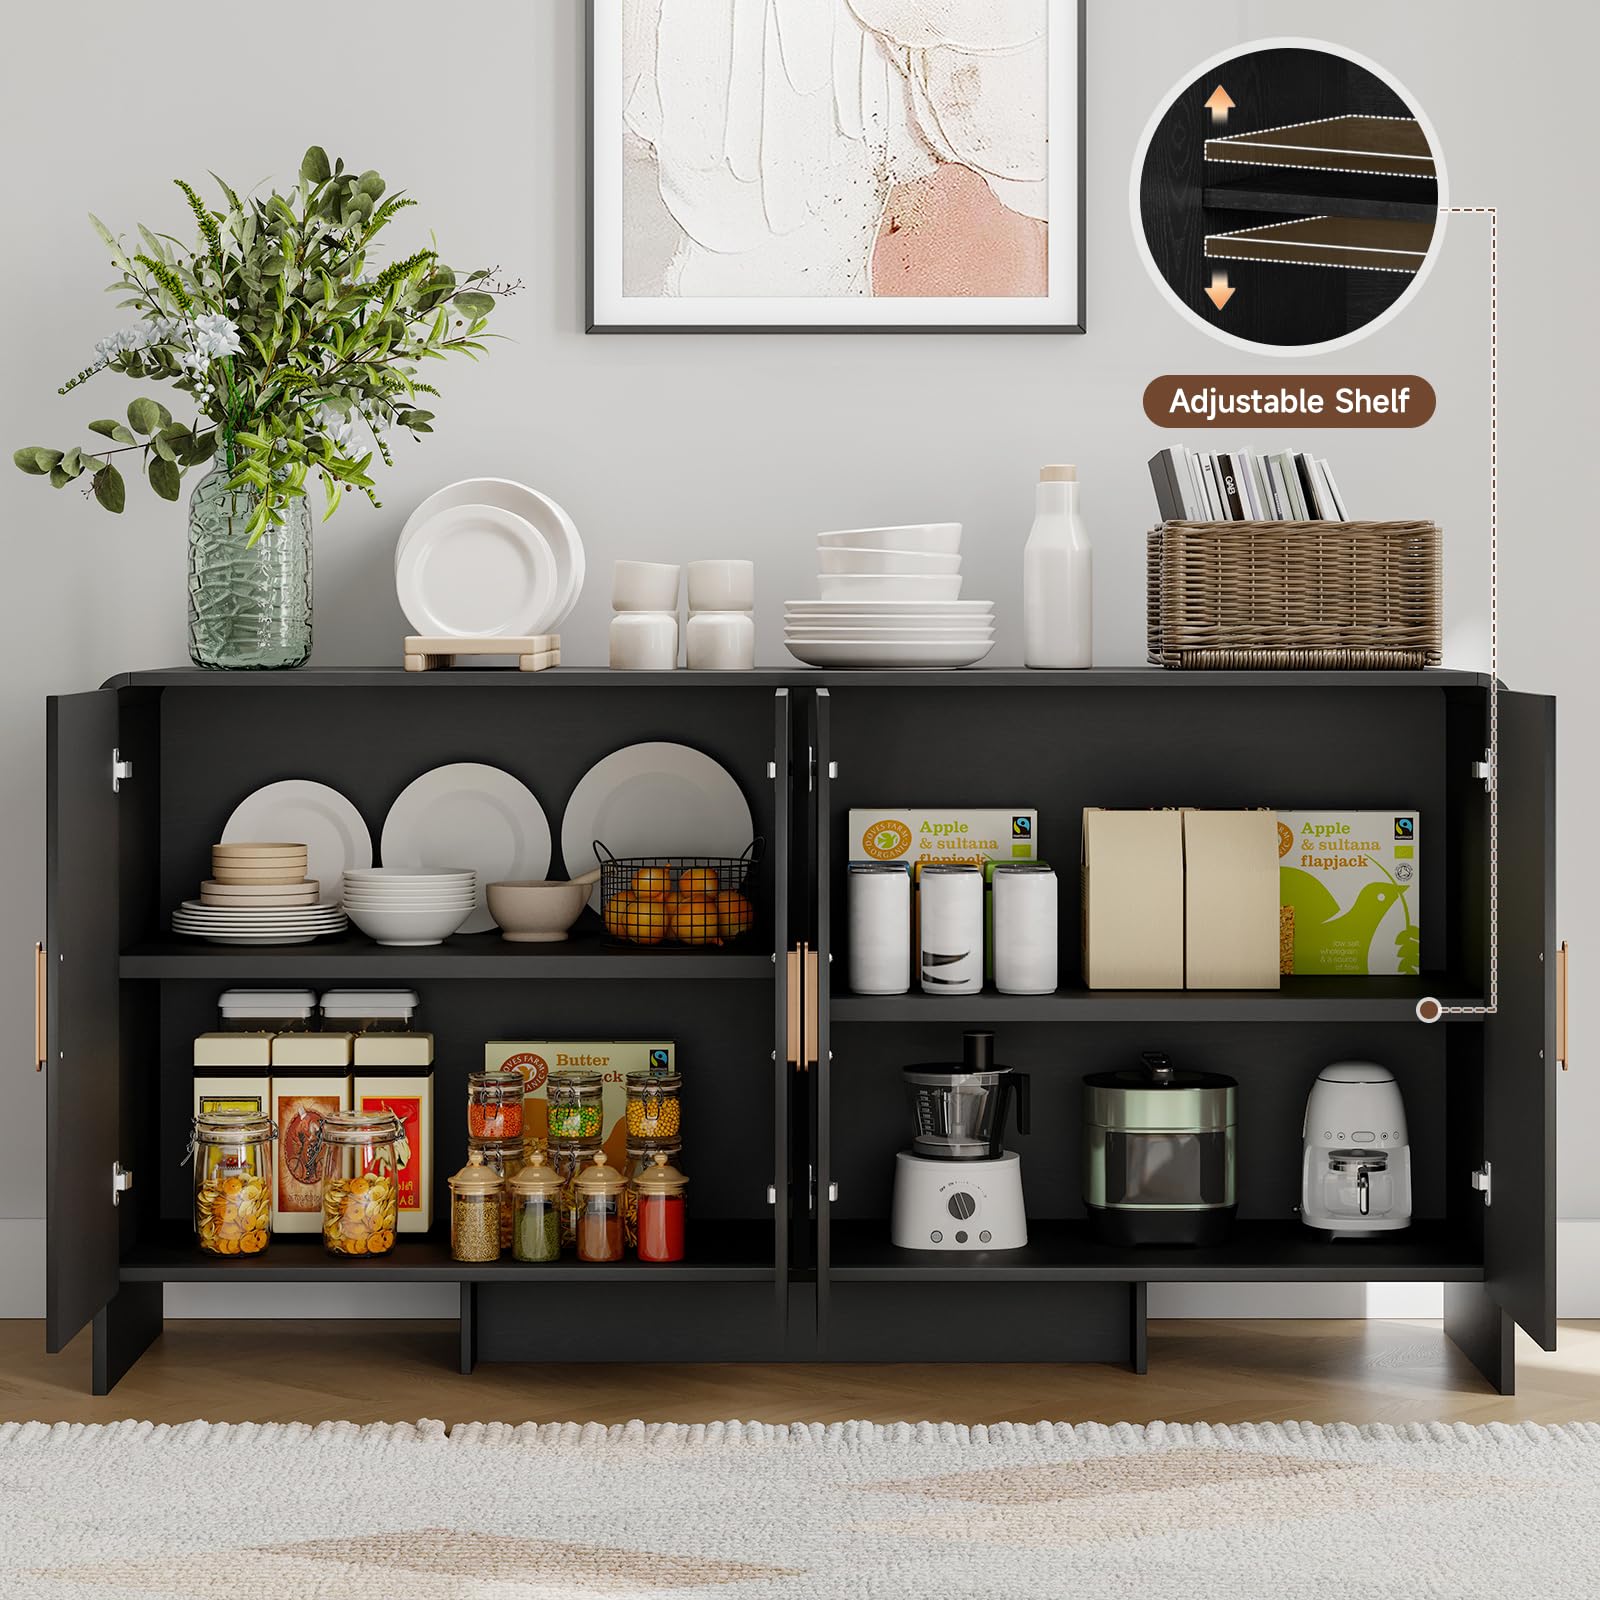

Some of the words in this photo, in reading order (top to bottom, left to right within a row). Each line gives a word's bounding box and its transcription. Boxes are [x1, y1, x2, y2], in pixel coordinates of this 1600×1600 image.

[919, 820, 969, 836] Apple
[1300, 821, 1351, 838] Apple
[919, 838, 933, 849] &
[936, 837, 998, 850] sultana
[1300, 838, 1316, 851] &
[1319, 838, 1382, 851] sultana
[1300, 854, 1369, 871] flapjack
[556, 1053, 610, 1067] Butter
